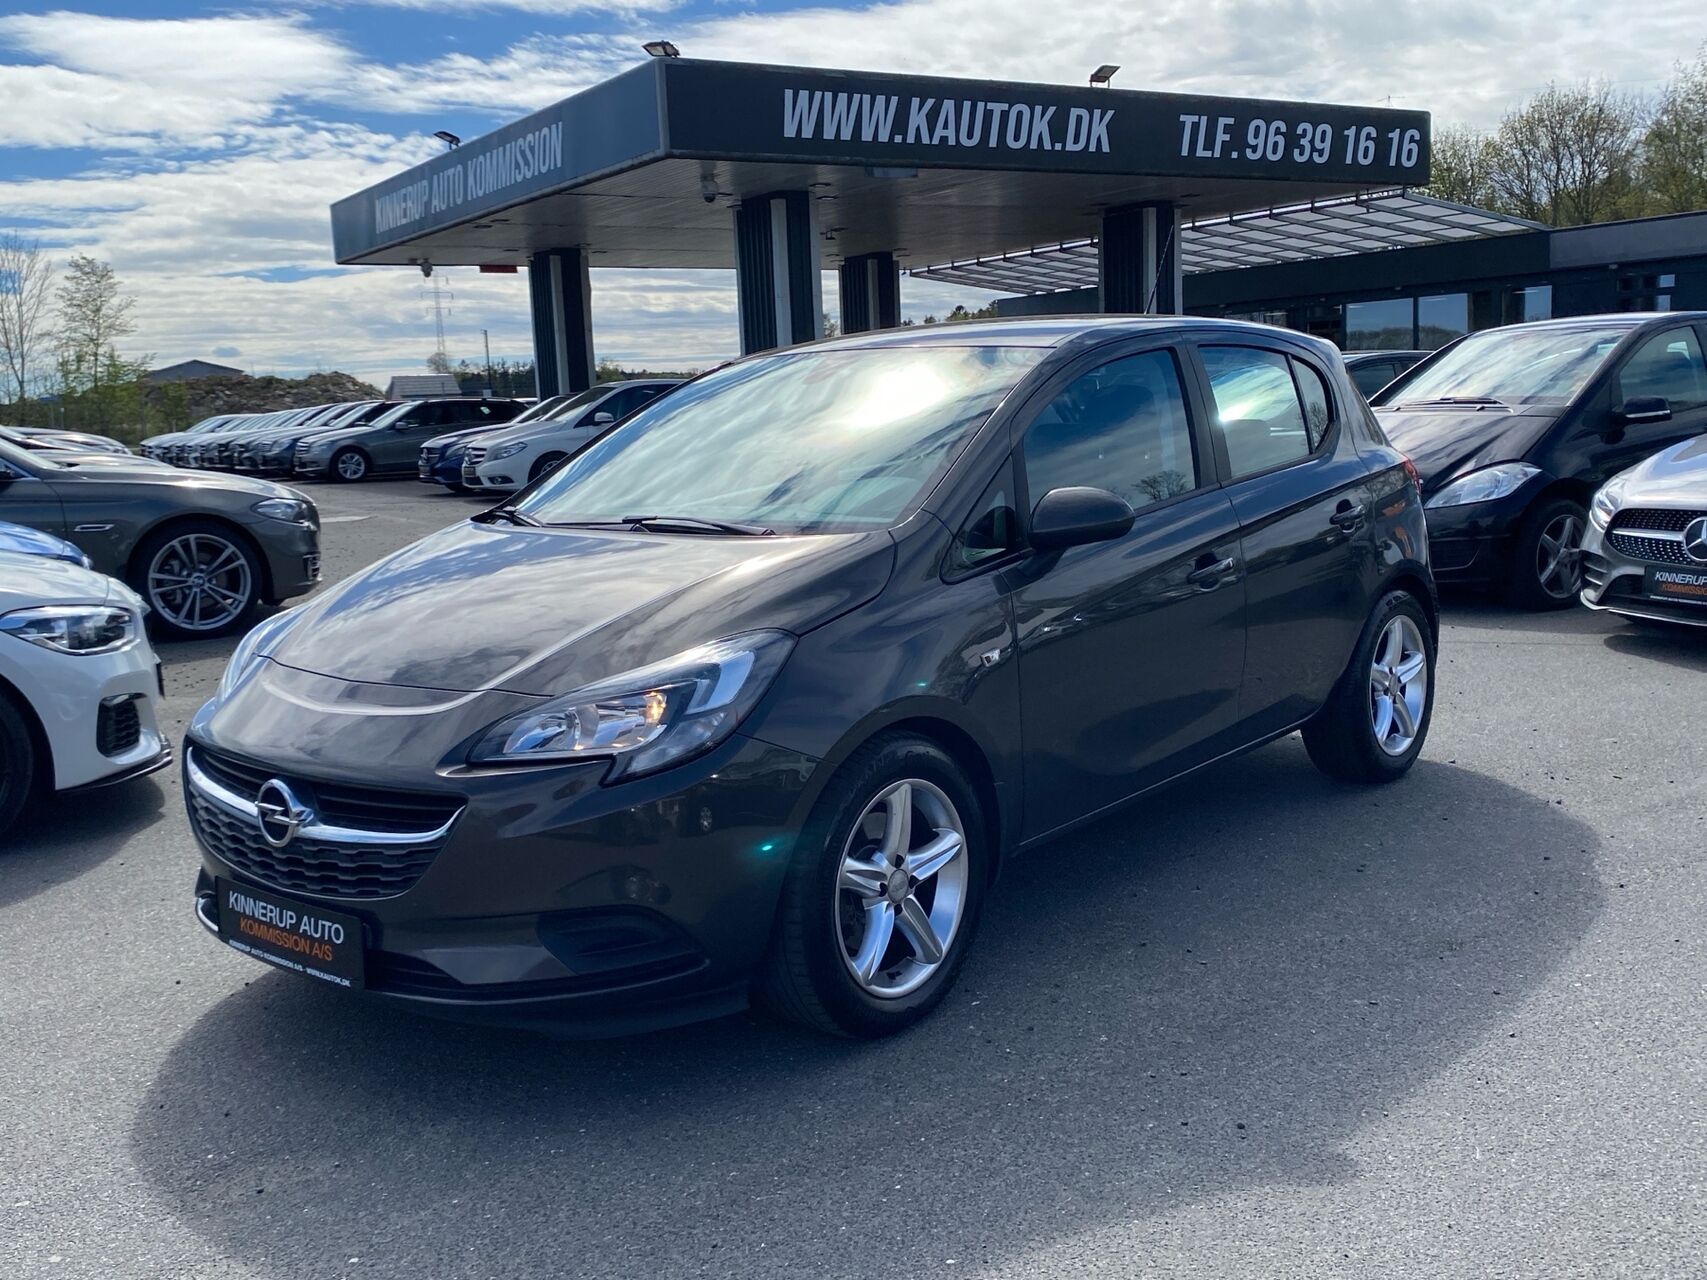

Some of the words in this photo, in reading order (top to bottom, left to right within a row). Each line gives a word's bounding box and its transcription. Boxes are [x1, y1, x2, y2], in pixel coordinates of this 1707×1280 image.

[783, 88, 1115, 153] WWW.KAUTOK.DK
[1179, 114, 1239, 159] TLF.
[1245, 118, 1287, 162] 96
[1293, 122, 1333, 164] 39
[1343, 125, 1377, 166] 16
[1387, 128, 1421, 168] 16
[375, 179, 429, 234] KINNERUP
[431, 164, 464, 214] AUTO
[467, 121, 563, 201] KOMMISSION
[228, 890, 296, 930] KINNERUP
[299, 915, 344, 944] AUTO
[240, 916, 310, 955] KOMMISSION
[312, 942, 333, 961] A/S
